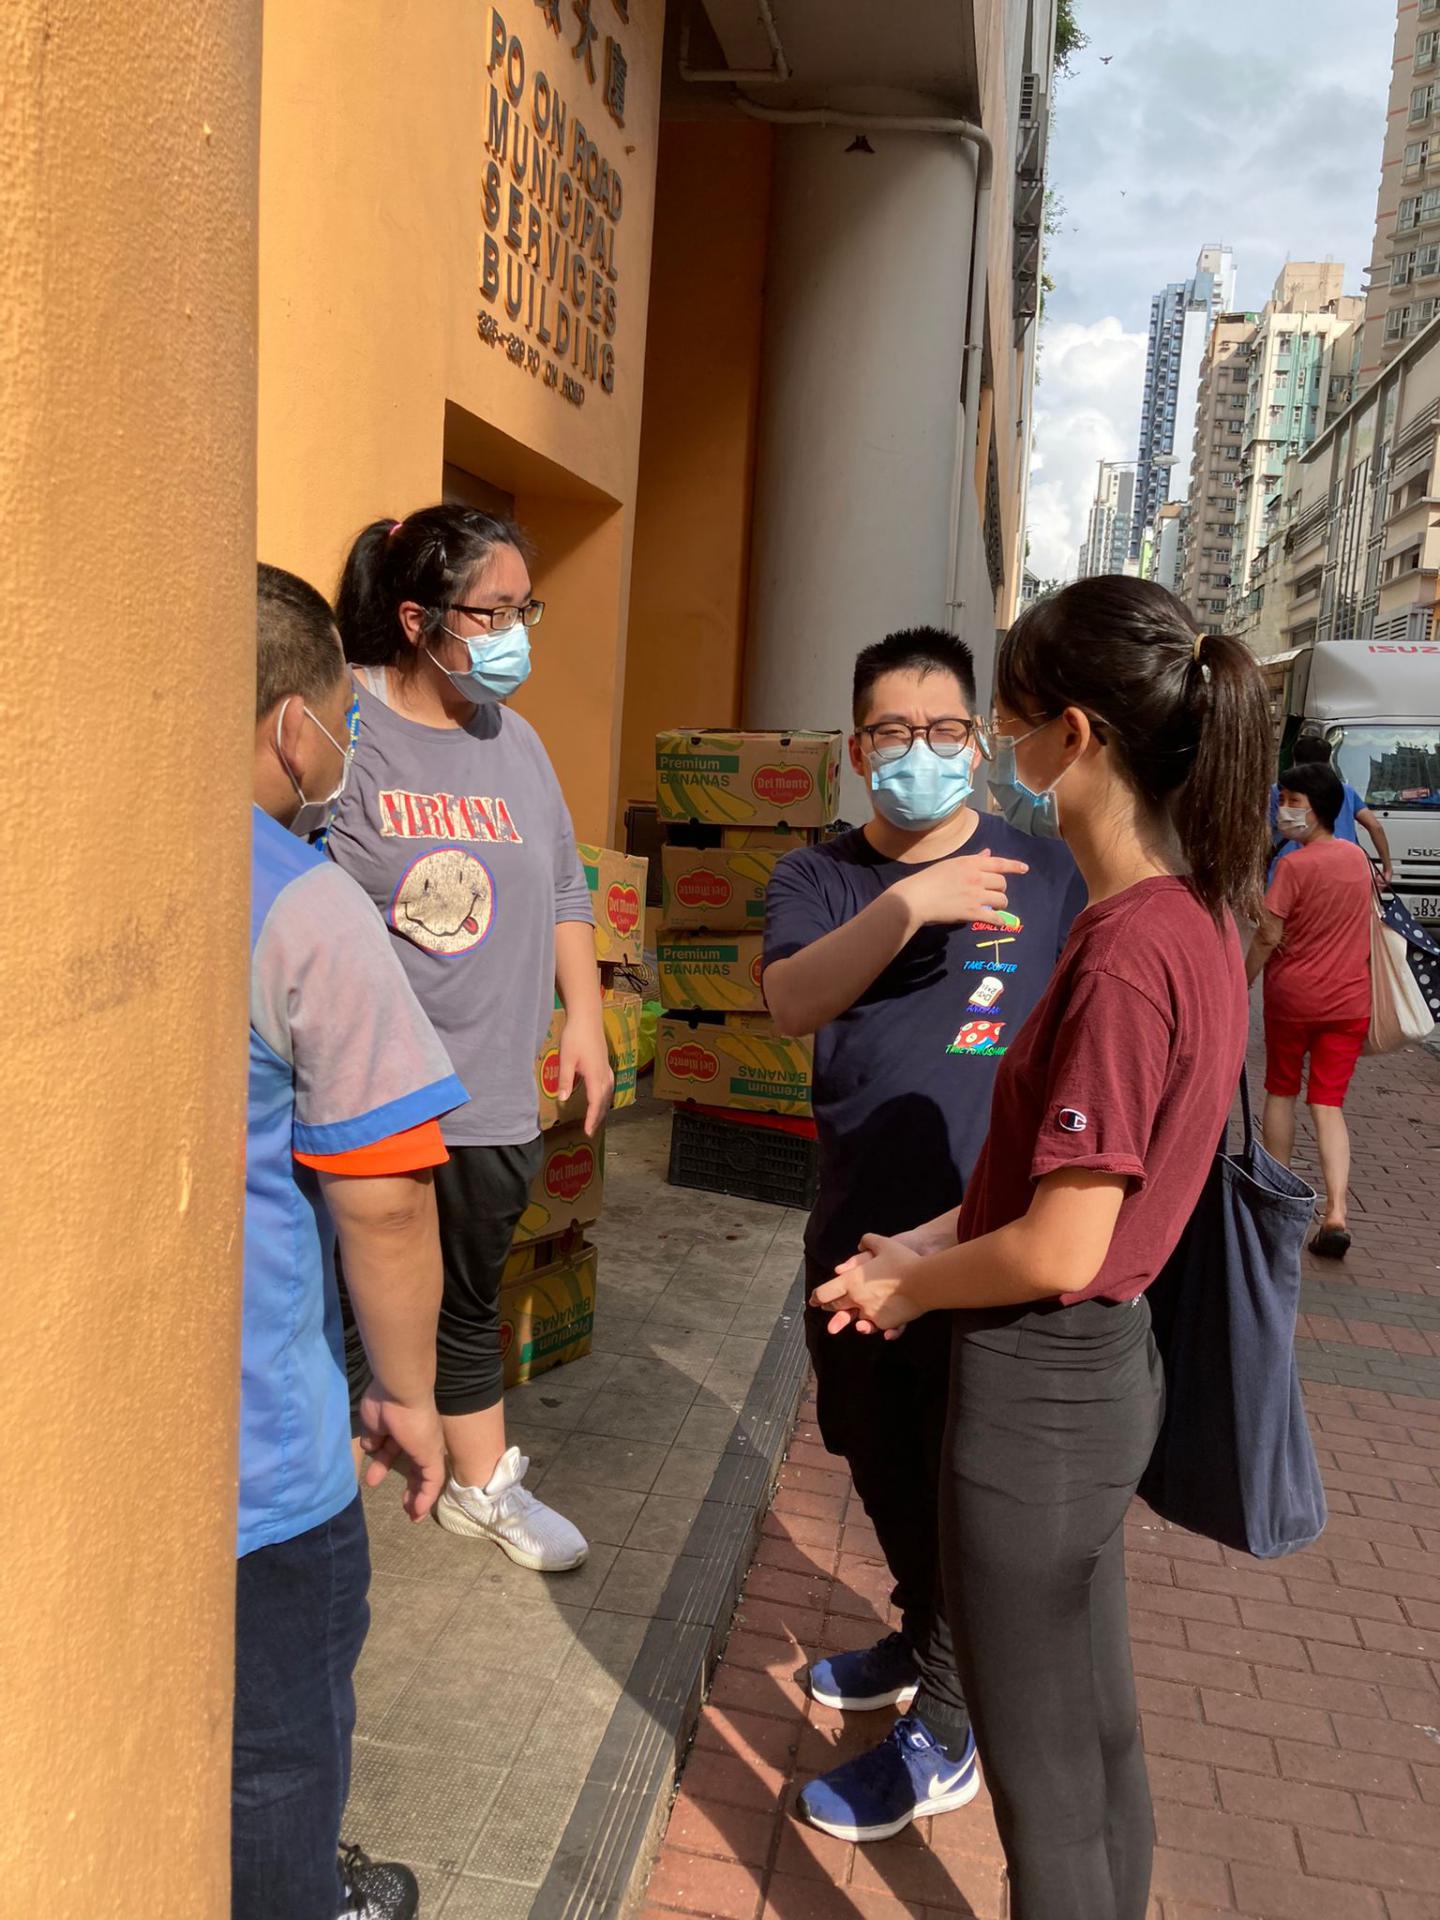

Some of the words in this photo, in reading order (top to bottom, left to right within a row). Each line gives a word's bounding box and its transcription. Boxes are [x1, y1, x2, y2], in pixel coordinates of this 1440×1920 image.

[487, 7, 525, 107] PO
[532, 71, 567, 158] ON
[570, 118, 622, 221] ROAD
[484, 82, 618, 282] MUNICIPAL
[481, 161, 617, 337] SERVICES
[480, 233, 616, 394] BUILDING
[660, 756, 720, 771] Premium
[660, 773, 731, 787] BANANAS
[757, 777, 774, 789] Del
[775, 777, 809, 790] Monte
[379, 789, 523, 844] NIRVANA
[663, 948, 720, 960] Premium
[664, 963, 730, 976] BANANAS
[738, 1065, 808, 1084] BANANAS
[747, 1082, 808, 1099] Premium
